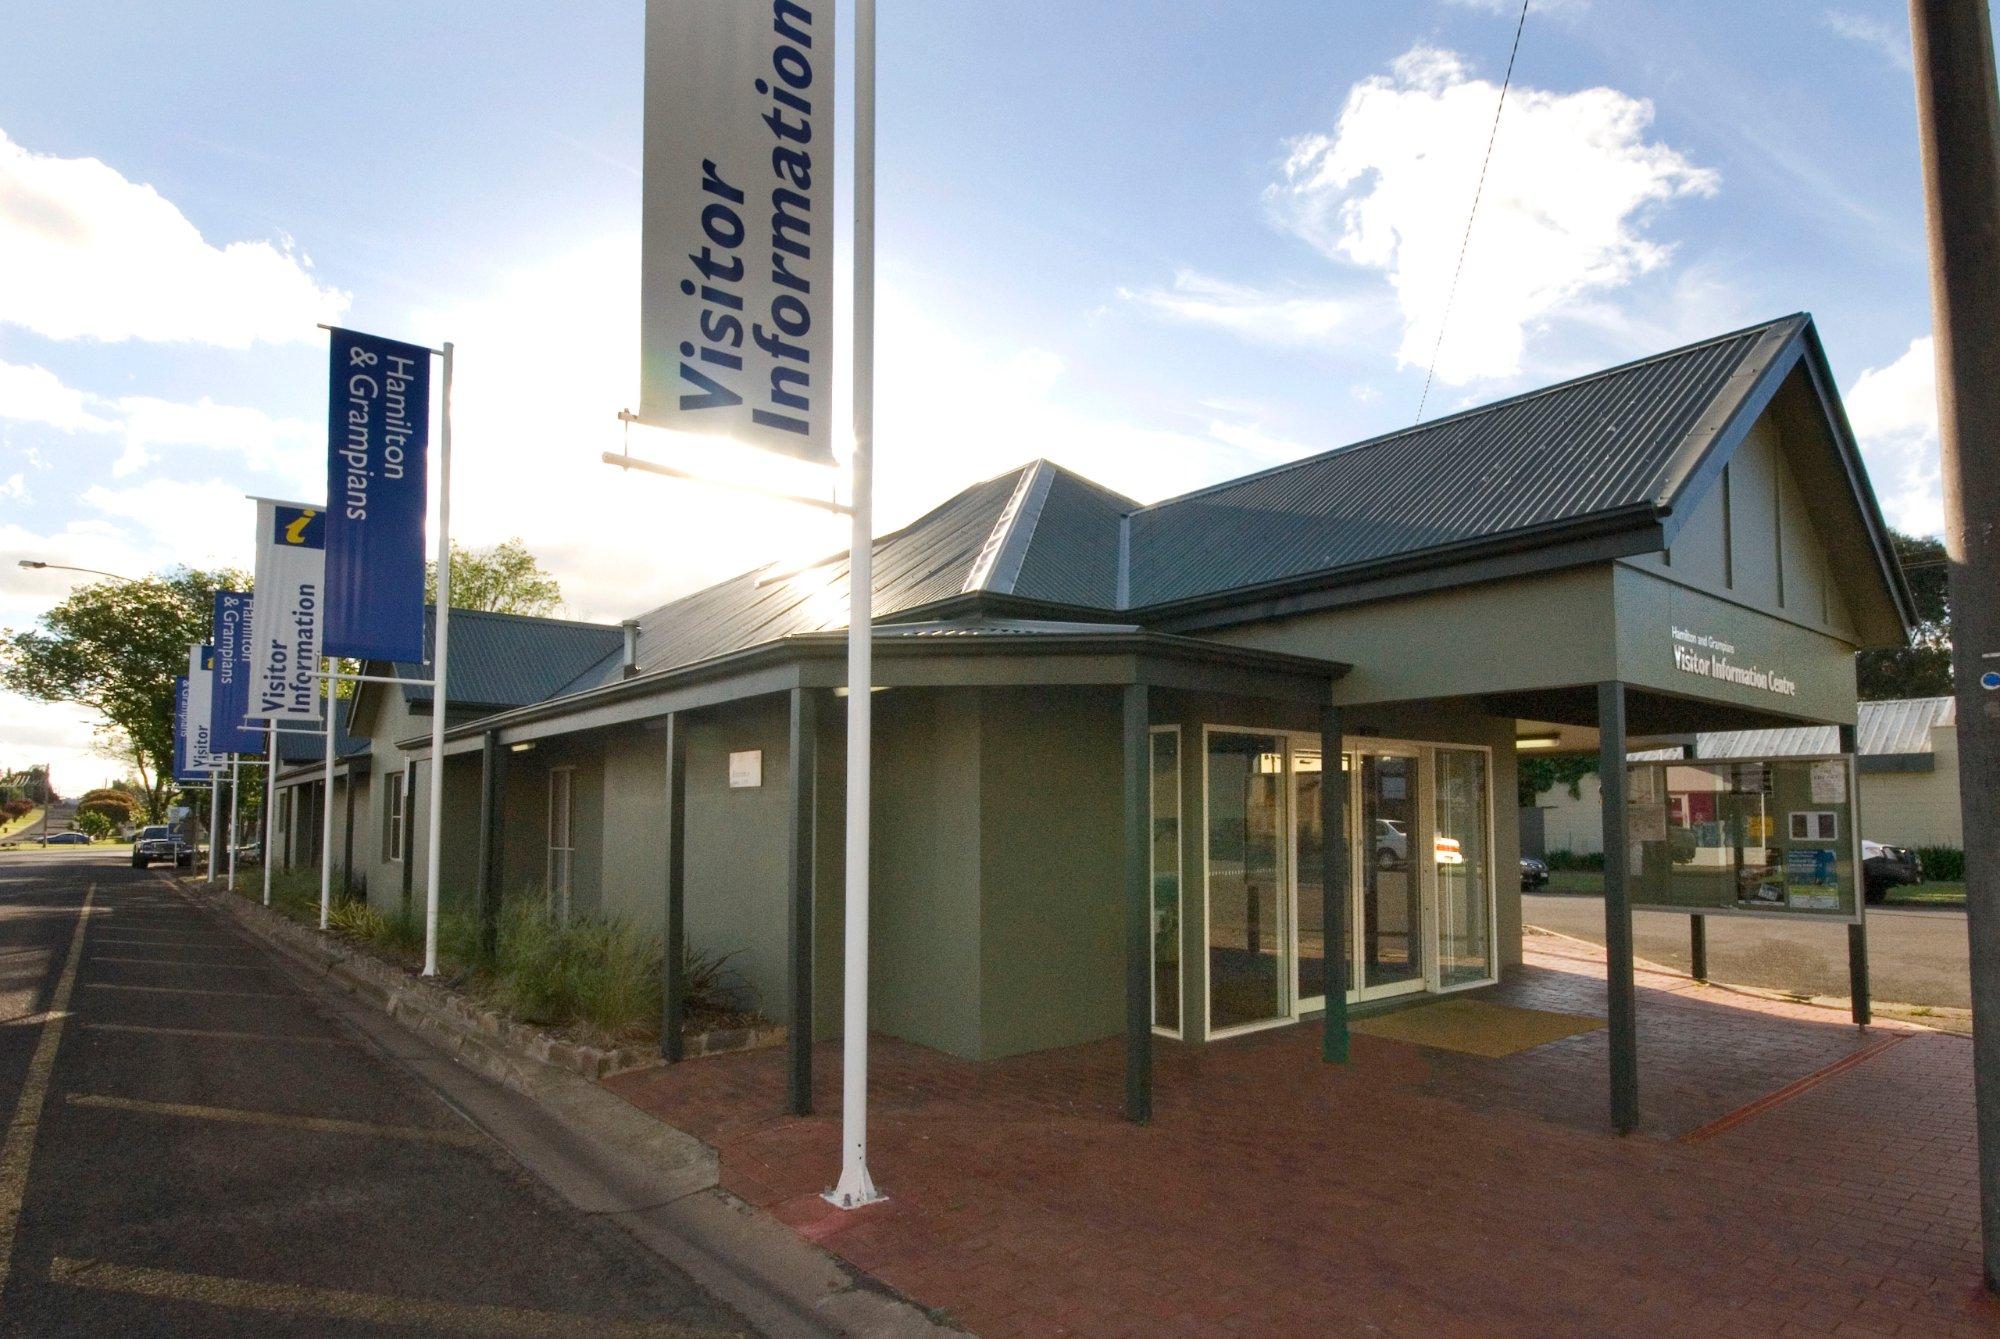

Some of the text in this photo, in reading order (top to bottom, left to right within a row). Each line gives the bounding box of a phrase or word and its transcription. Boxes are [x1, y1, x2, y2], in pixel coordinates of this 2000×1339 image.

[752, 0, 813, 436] Information
[679, 158, 745, 411] Visitor
[339, 346, 378, 520] & Grampians
[384, 354, 415, 479] Hamilton
[218, 596, 239, 684] & Grampians
[261, 639, 287, 712] Visitor
[288, 584, 316, 713] Information
[1673, 644, 1796, 696] Visitor Information Centre
[193, 725, 208, 768] Visitor
